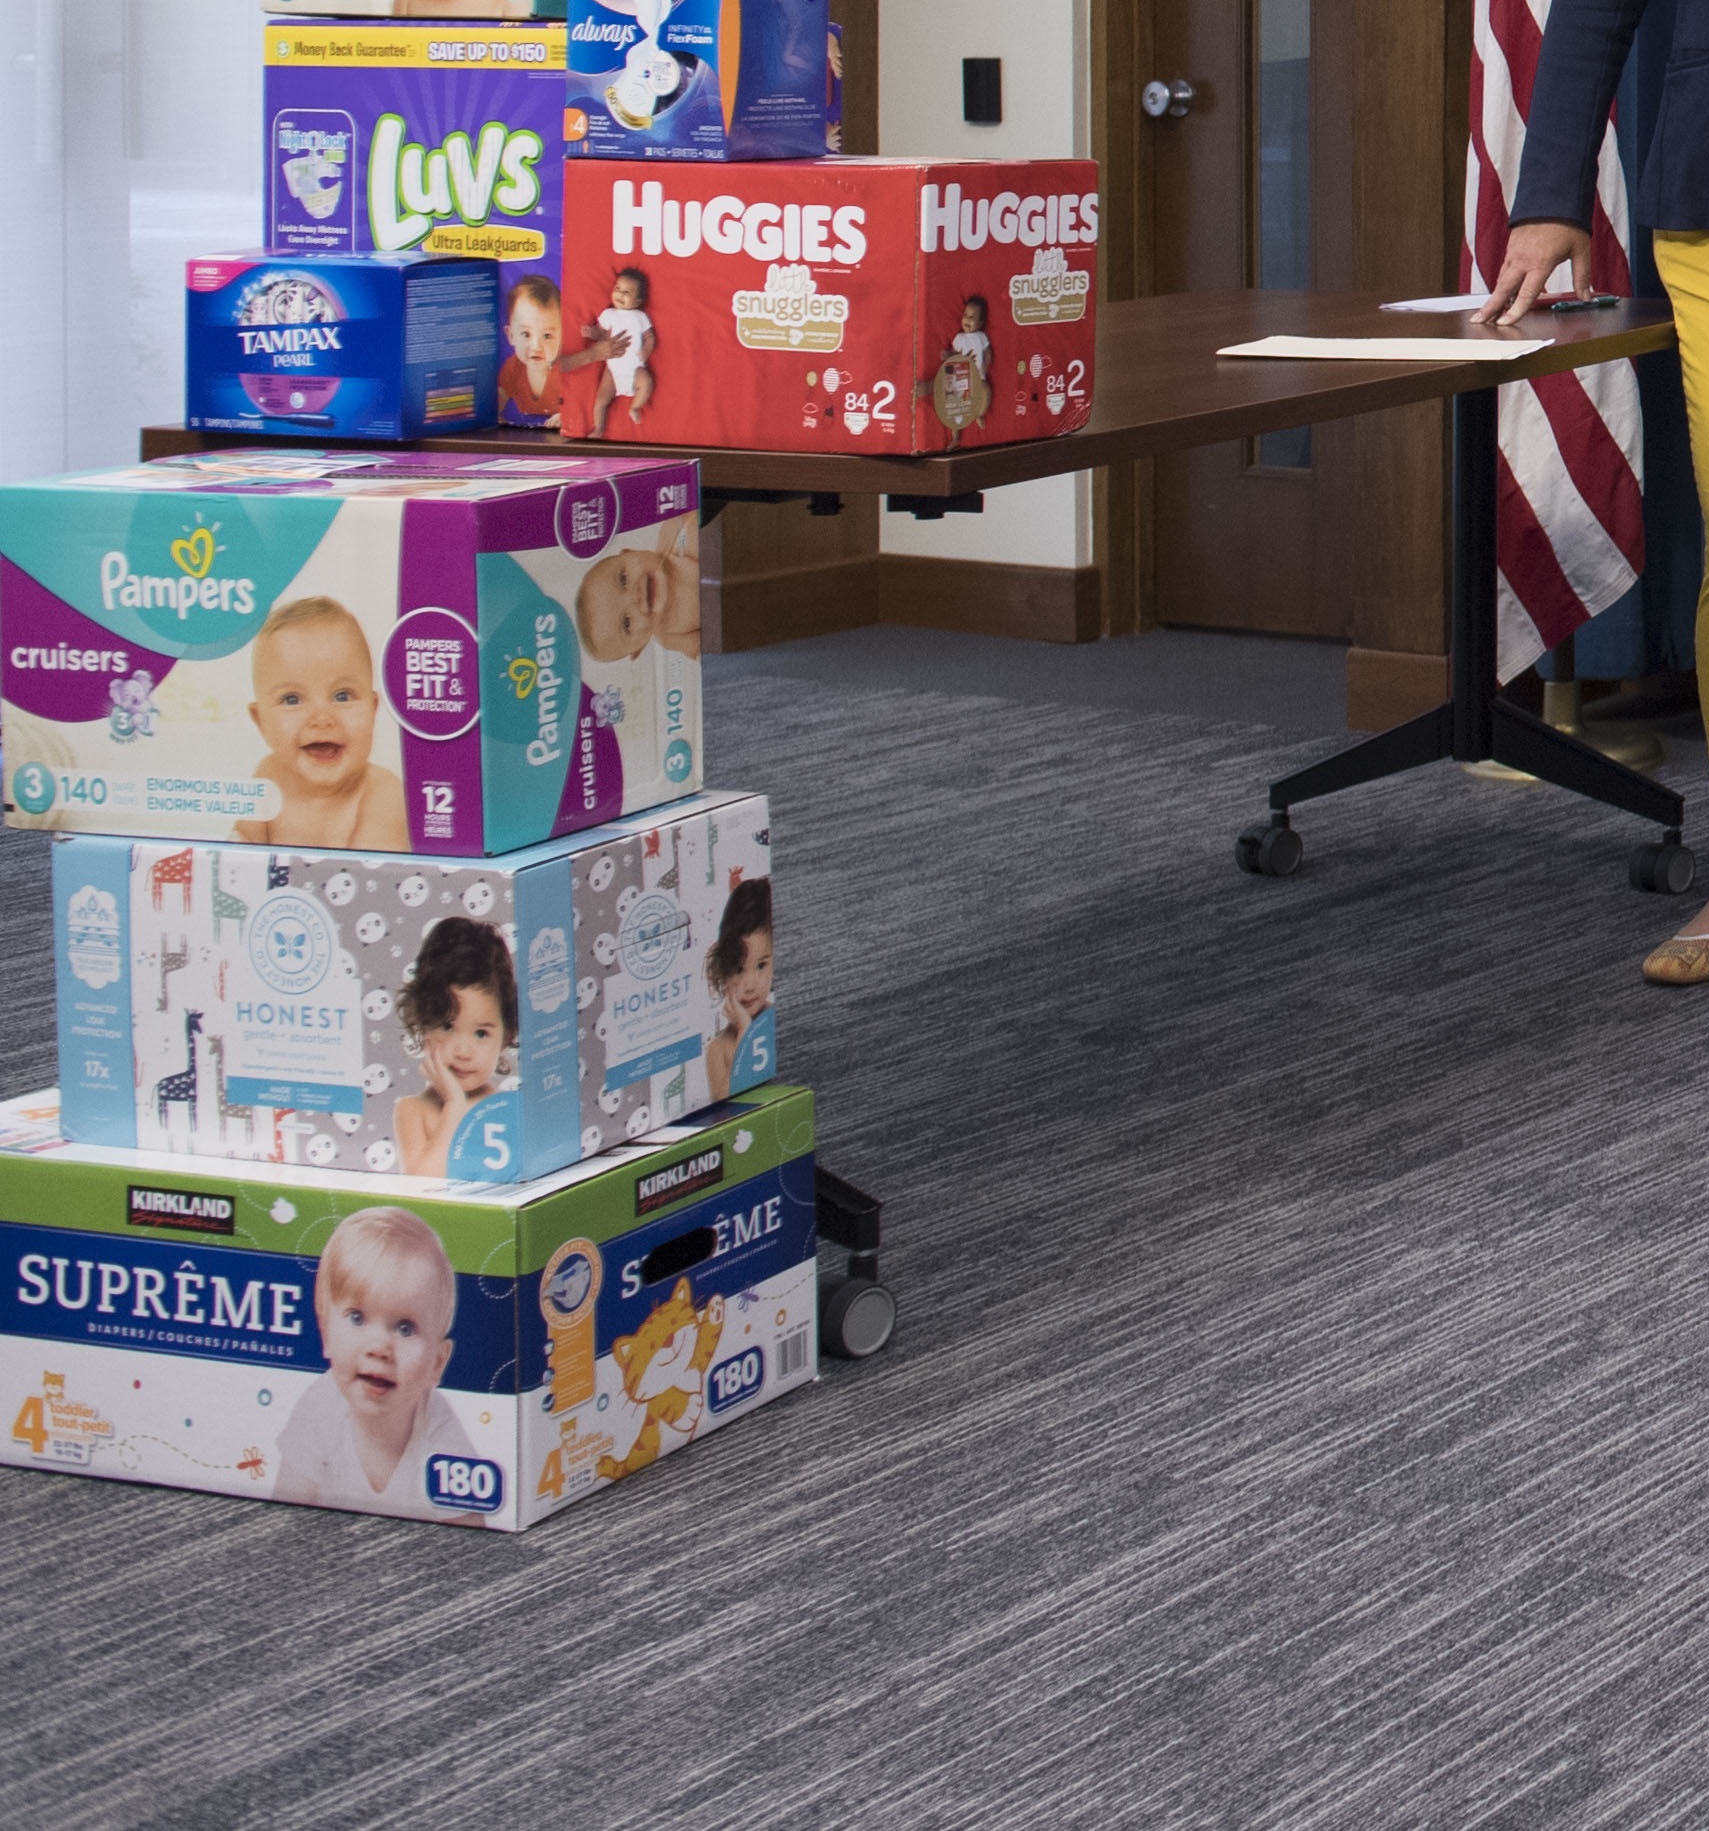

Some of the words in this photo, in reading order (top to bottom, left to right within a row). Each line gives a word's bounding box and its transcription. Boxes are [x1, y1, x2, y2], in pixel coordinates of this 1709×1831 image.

[293, 41, 326, 59] Money
[329, 41, 353, 57] Back
[356, 42, 407, 57] Guarantee
[428, 42, 464, 62] SAVE
[467, 42, 487, 61] UP
[490, 43, 508, 61] TO
[512, 44, 546, 62] $150
[571, 16, 637, 51] always
[612, 179, 867, 266] HUGGIES
[920, 182, 1099, 253] HUGGIES
[432, 234, 462, 250] Ultra
[465, 235, 538, 257] Leakguards
[1011, 272, 1088, 299] snugglers
[736, 293, 845, 323] snugglers
[237, 326, 343, 355] TAMPAX
[1046, 375, 1065, 393] 84
[1066, 359, 1085, 397] 2
[844, 392, 869, 411] 84
[872, 380, 896, 421] 2
[100, 551, 255, 620] Pampers
[10, 642, 130, 673] cruisers
[406, 651, 463, 674] BEST
[406, 674, 447, 699] FIT
[449, 679, 463, 696] &
[526, 613, 562, 767] Pampers
[665, 688, 684, 735] 140
[579, 716, 597, 810] cruisers
[666, 750, 685, 770] 3
[23, 766, 44, 799] 3
[60, 775, 107, 805] 140
[146, 777, 220, 796] ENORMOUS
[223, 780, 265, 798] VALUE
[422, 786, 455, 813] 12
[147, 797, 201, 813] ENORME
[204, 799, 255, 815] VALEUR
[613, 974, 693, 1018] HONEST
[236, 1001, 348, 1031] HONEST
[751, 1035, 768, 1072] 5
[483, 1123, 511, 1170] 5
[638, 1150, 721, 1201] KIRKLAND
[132, 1190, 231, 1219] KIRKLAND
[17, 1253, 304, 1336] SUPRÊME
[712, 1353, 761, 1398] 180
[432, 1459, 495, 1501] 180
[537, 1447, 566, 1499] 4
